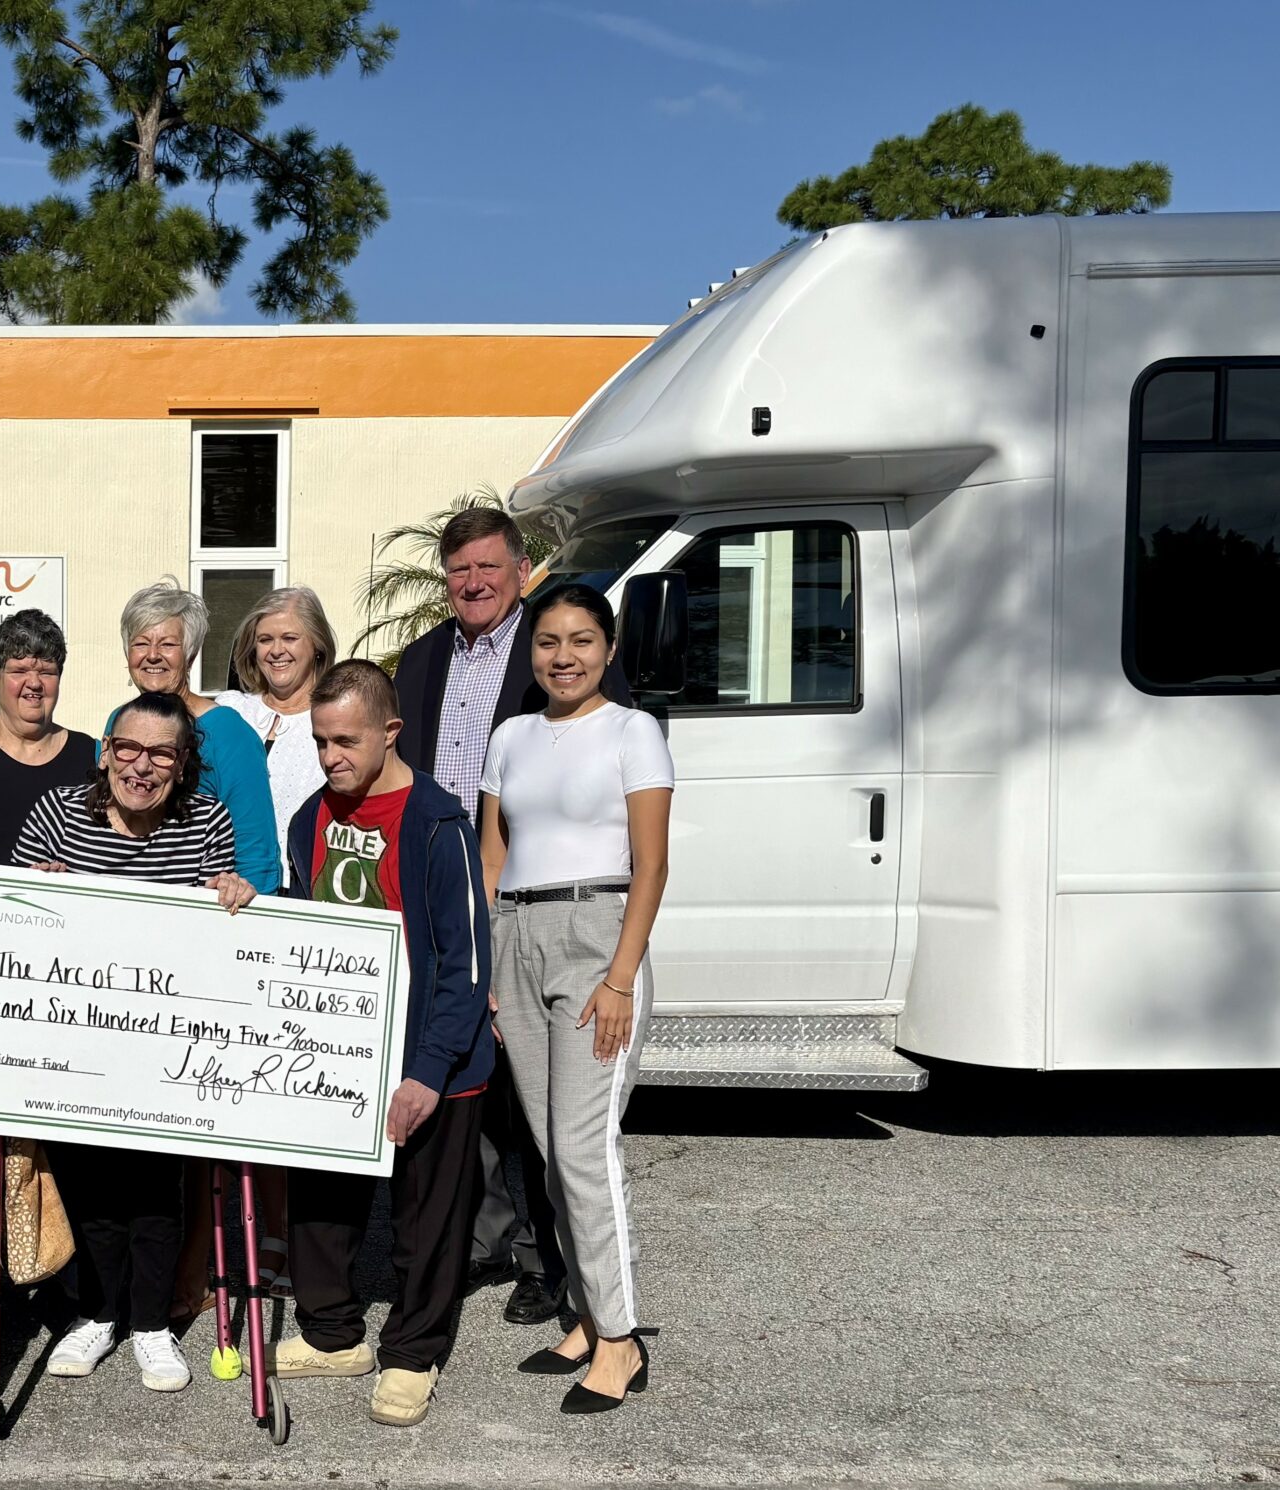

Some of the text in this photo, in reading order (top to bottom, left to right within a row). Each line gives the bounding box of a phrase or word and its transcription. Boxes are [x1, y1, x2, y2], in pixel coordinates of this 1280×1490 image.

[236, 949, 276, 965] DATE:
[289, 945, 380, 977] 4/1/2026
[45, 957, 85, 986] Arc
[93, 962, 118, 989] of
[122, 966, 180, 996] IRC
[257, 979, 265, 992] $
[48, 997, 77, 1025] Six
[87, 1003, 160, 1034] Hundred
[170, 1015, 231, 1049] Eighty
[239, 1025, 270, 1047] Five
[311, 1042, 374, 1059] DOLLARS
[42, 1057, 70, 1072] Fund
[24, 1099, 216, 1131] www.ircommunityfoundation.org
